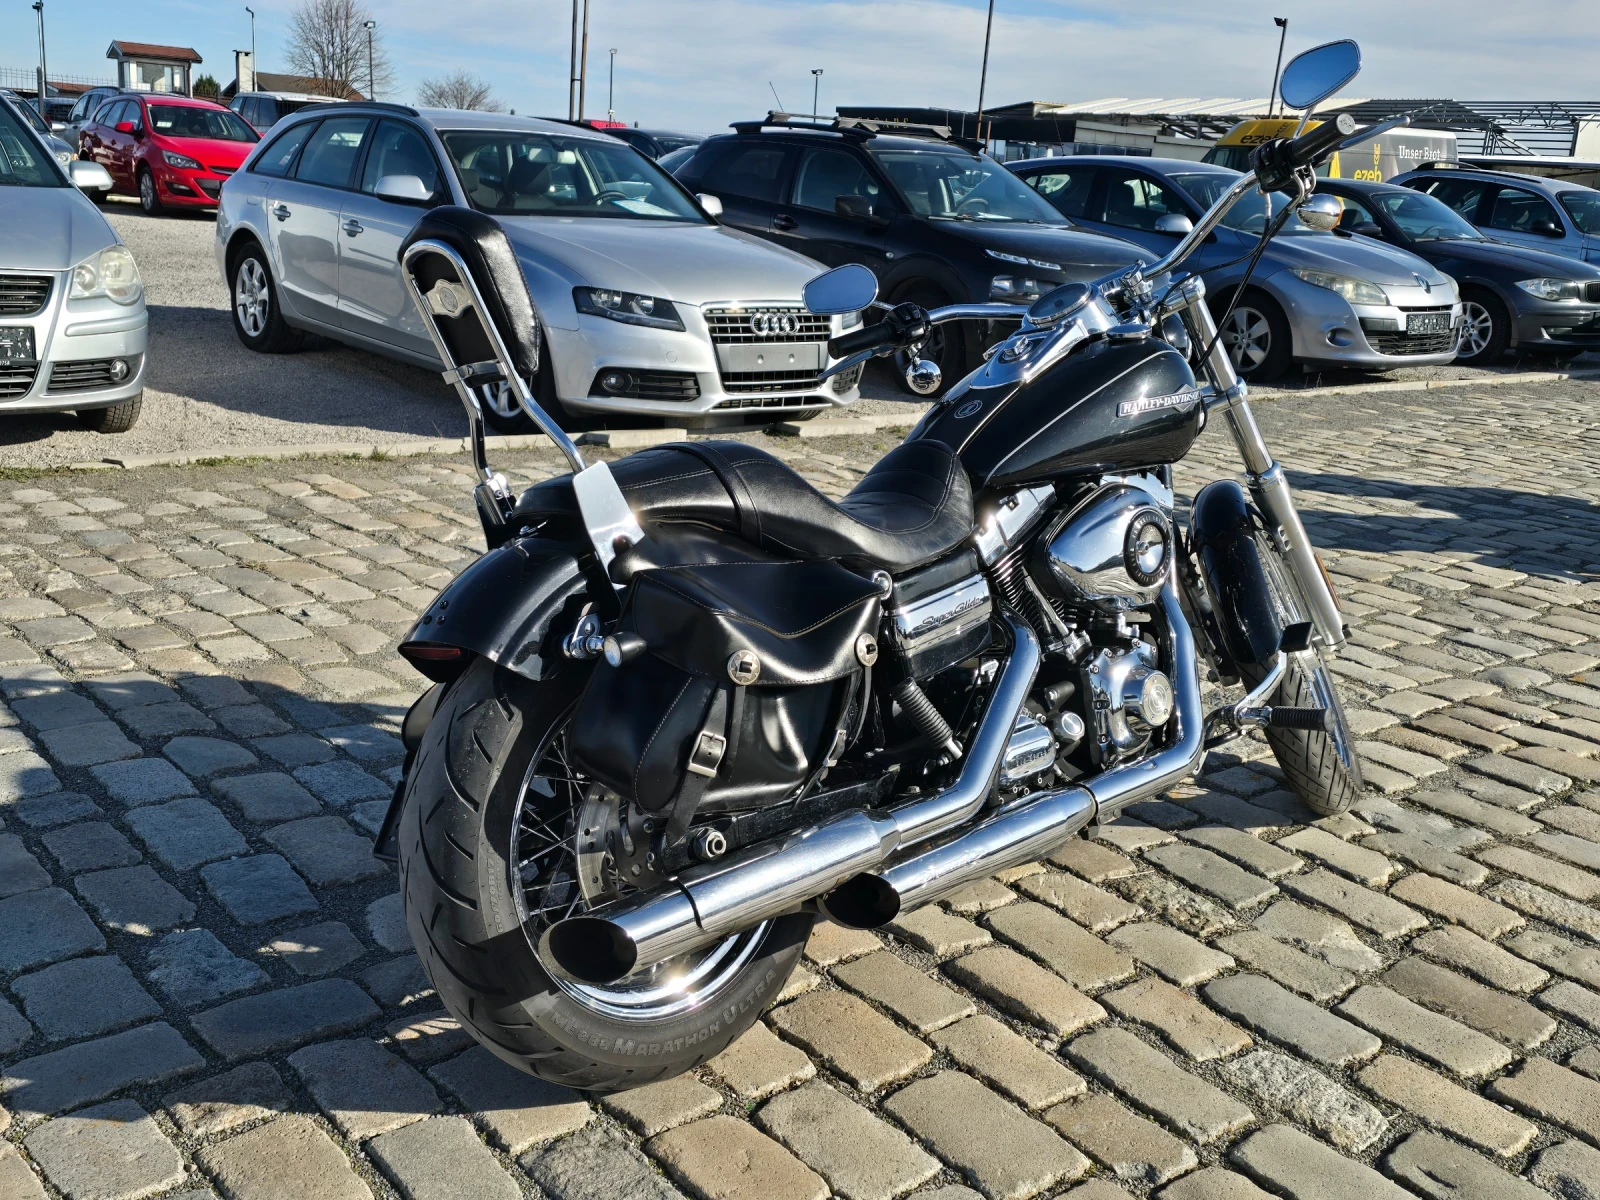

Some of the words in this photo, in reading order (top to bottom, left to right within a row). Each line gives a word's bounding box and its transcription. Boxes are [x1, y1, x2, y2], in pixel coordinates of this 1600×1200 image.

[1399, 145, 1422, 159] Unser
[1423, 147, 1441, 160] Brot
[1354, 166, 1382, 182] ezeb
[613, 1020, 721, 1056] MARATHON
[722, 969, 777, 1024] ULTRA
